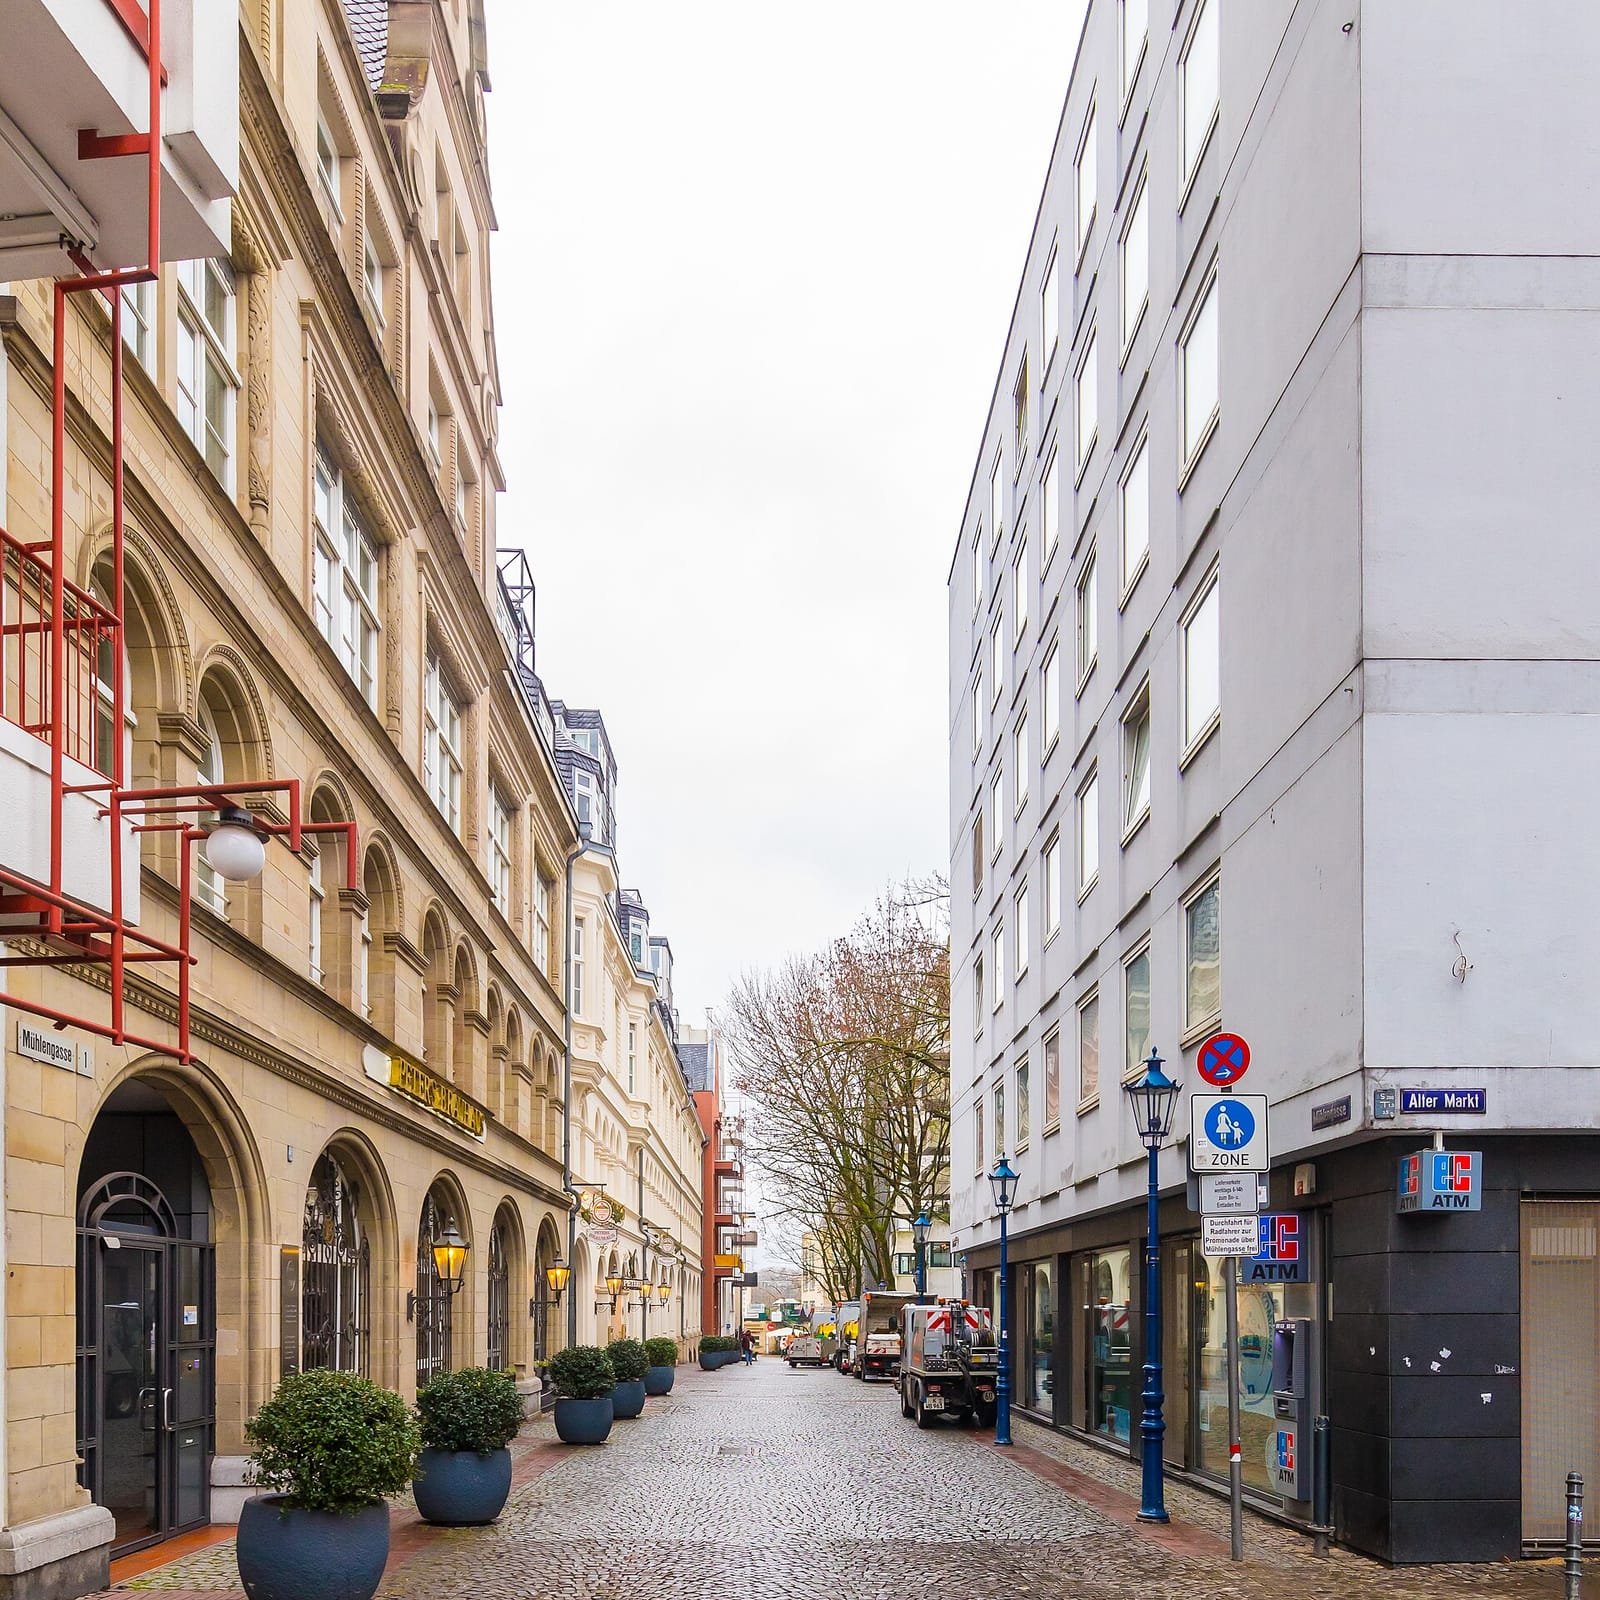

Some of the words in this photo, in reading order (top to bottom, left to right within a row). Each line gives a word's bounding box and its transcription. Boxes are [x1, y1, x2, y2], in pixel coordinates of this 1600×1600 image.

[22, 1029, 73, 1063] Mühlengasse
[1408, 1093, 1438, 1109] Alter
[1444, 1093, 1479, 1109] Markt
[1211, 1153, 1249, 1166] ZONE
[1400, 1196, 1418, 1210] ATM
[1432, 1195, 1470, 1208] ATM
[1205, 1245, 1246, 1254] Mühlengasse
[1246, 1244, 1258, 1252] frei
[1251, 1263, 1298, 1280] ATM
[1278, 1469, 1294, 1485] ATM
